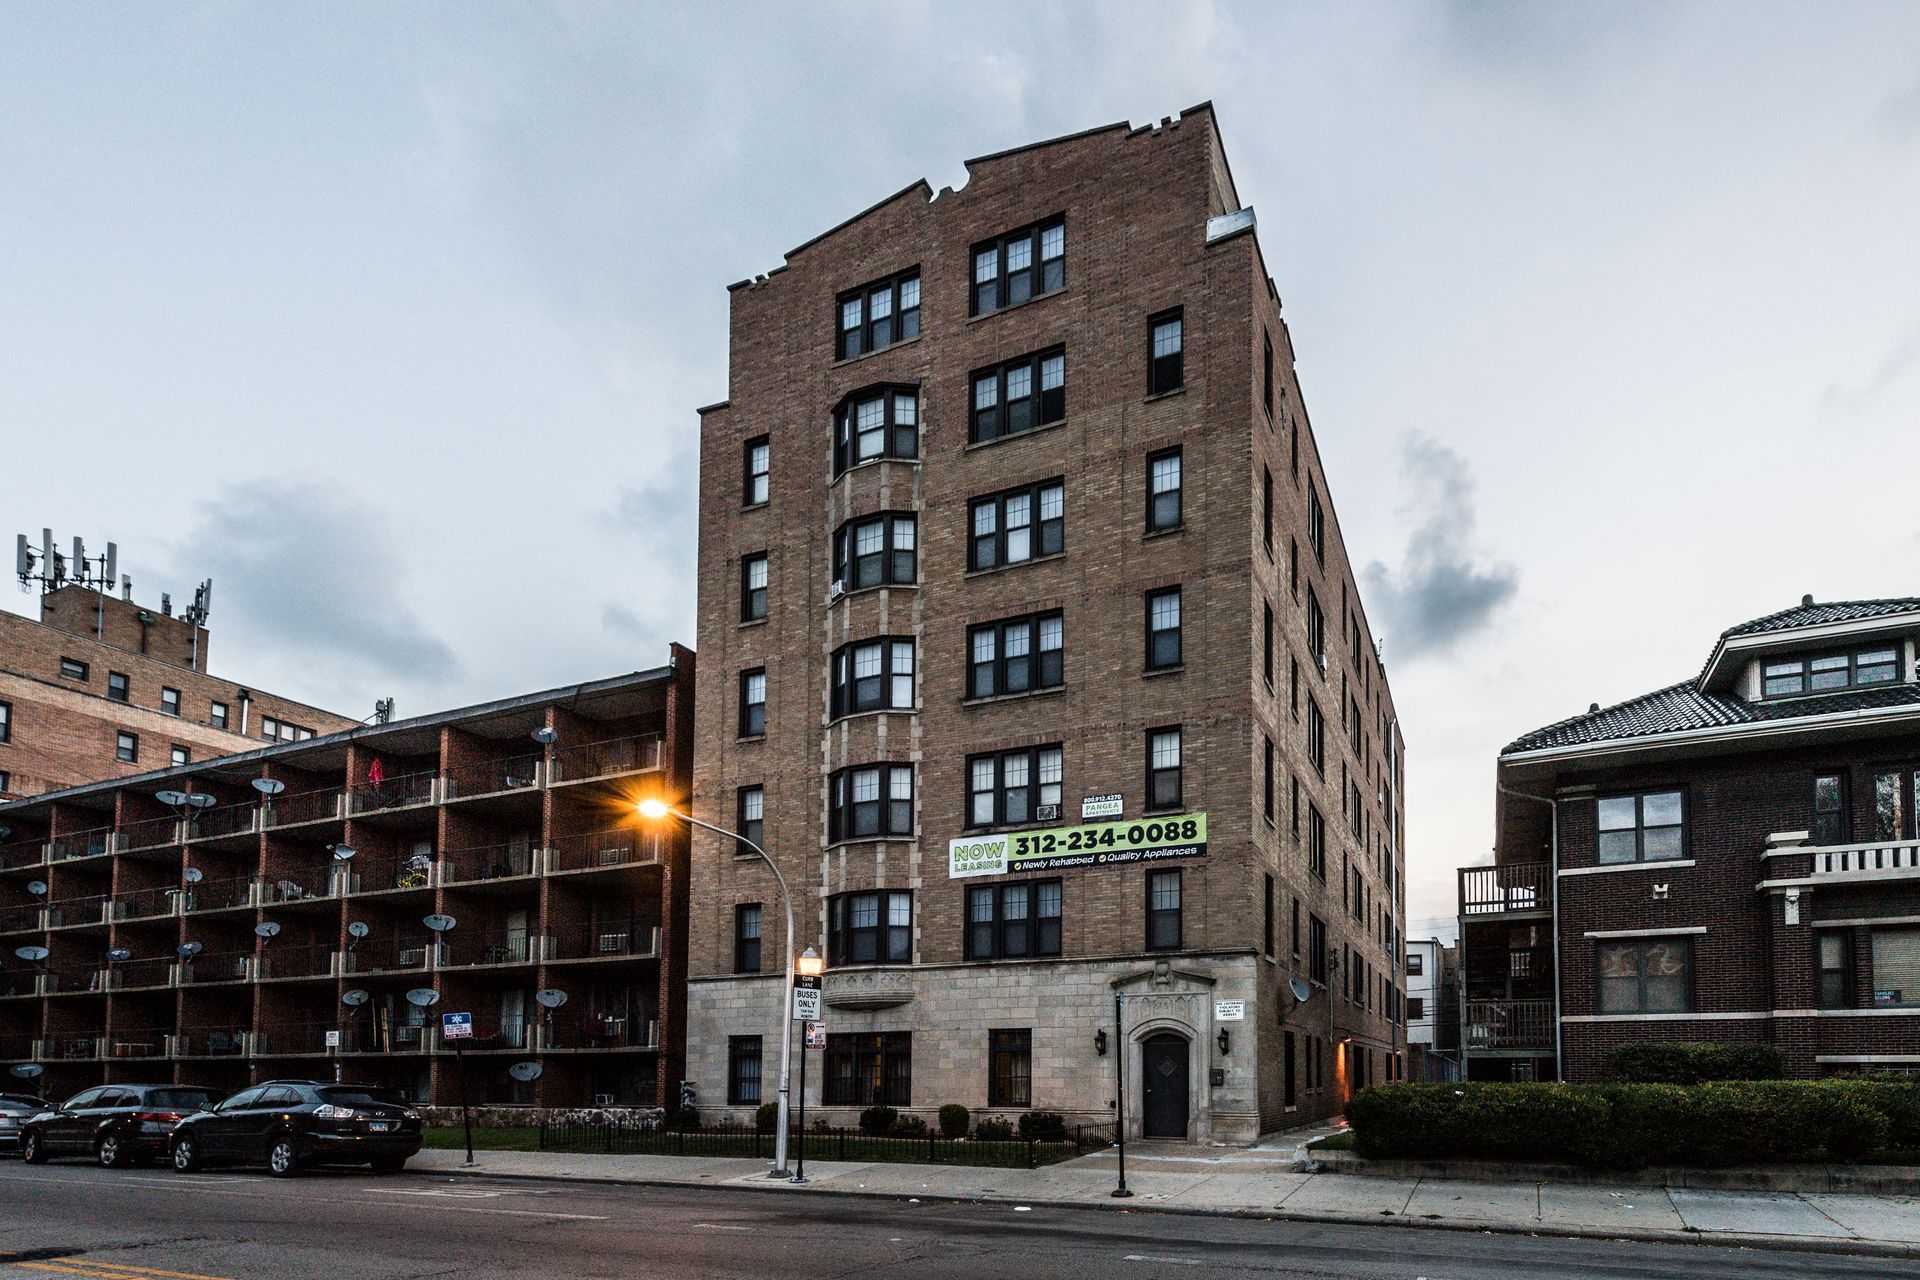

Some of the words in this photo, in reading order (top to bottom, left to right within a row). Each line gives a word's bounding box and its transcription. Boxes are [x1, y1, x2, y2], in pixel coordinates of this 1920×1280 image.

[1084, 794, 1122, 803] 800.912.4270
[1085, 802, 1119, 811] PANGEA
[1015, 820, 1198, 855] 312-234-0088
[954, 842, 1005, 862] NOW
[1022, 860, 1048, 870] Newly
[1049, 855, 1095, 867] Rehabbed
[1107, 851, 1142, 861] Quality
[1143, 847, 1197, 860] Appliances
[954, 860, 1002, 872] LEASING
[797, 990, 818, 999] BUSES
[798, 1000, 816, 1008] ONLY
